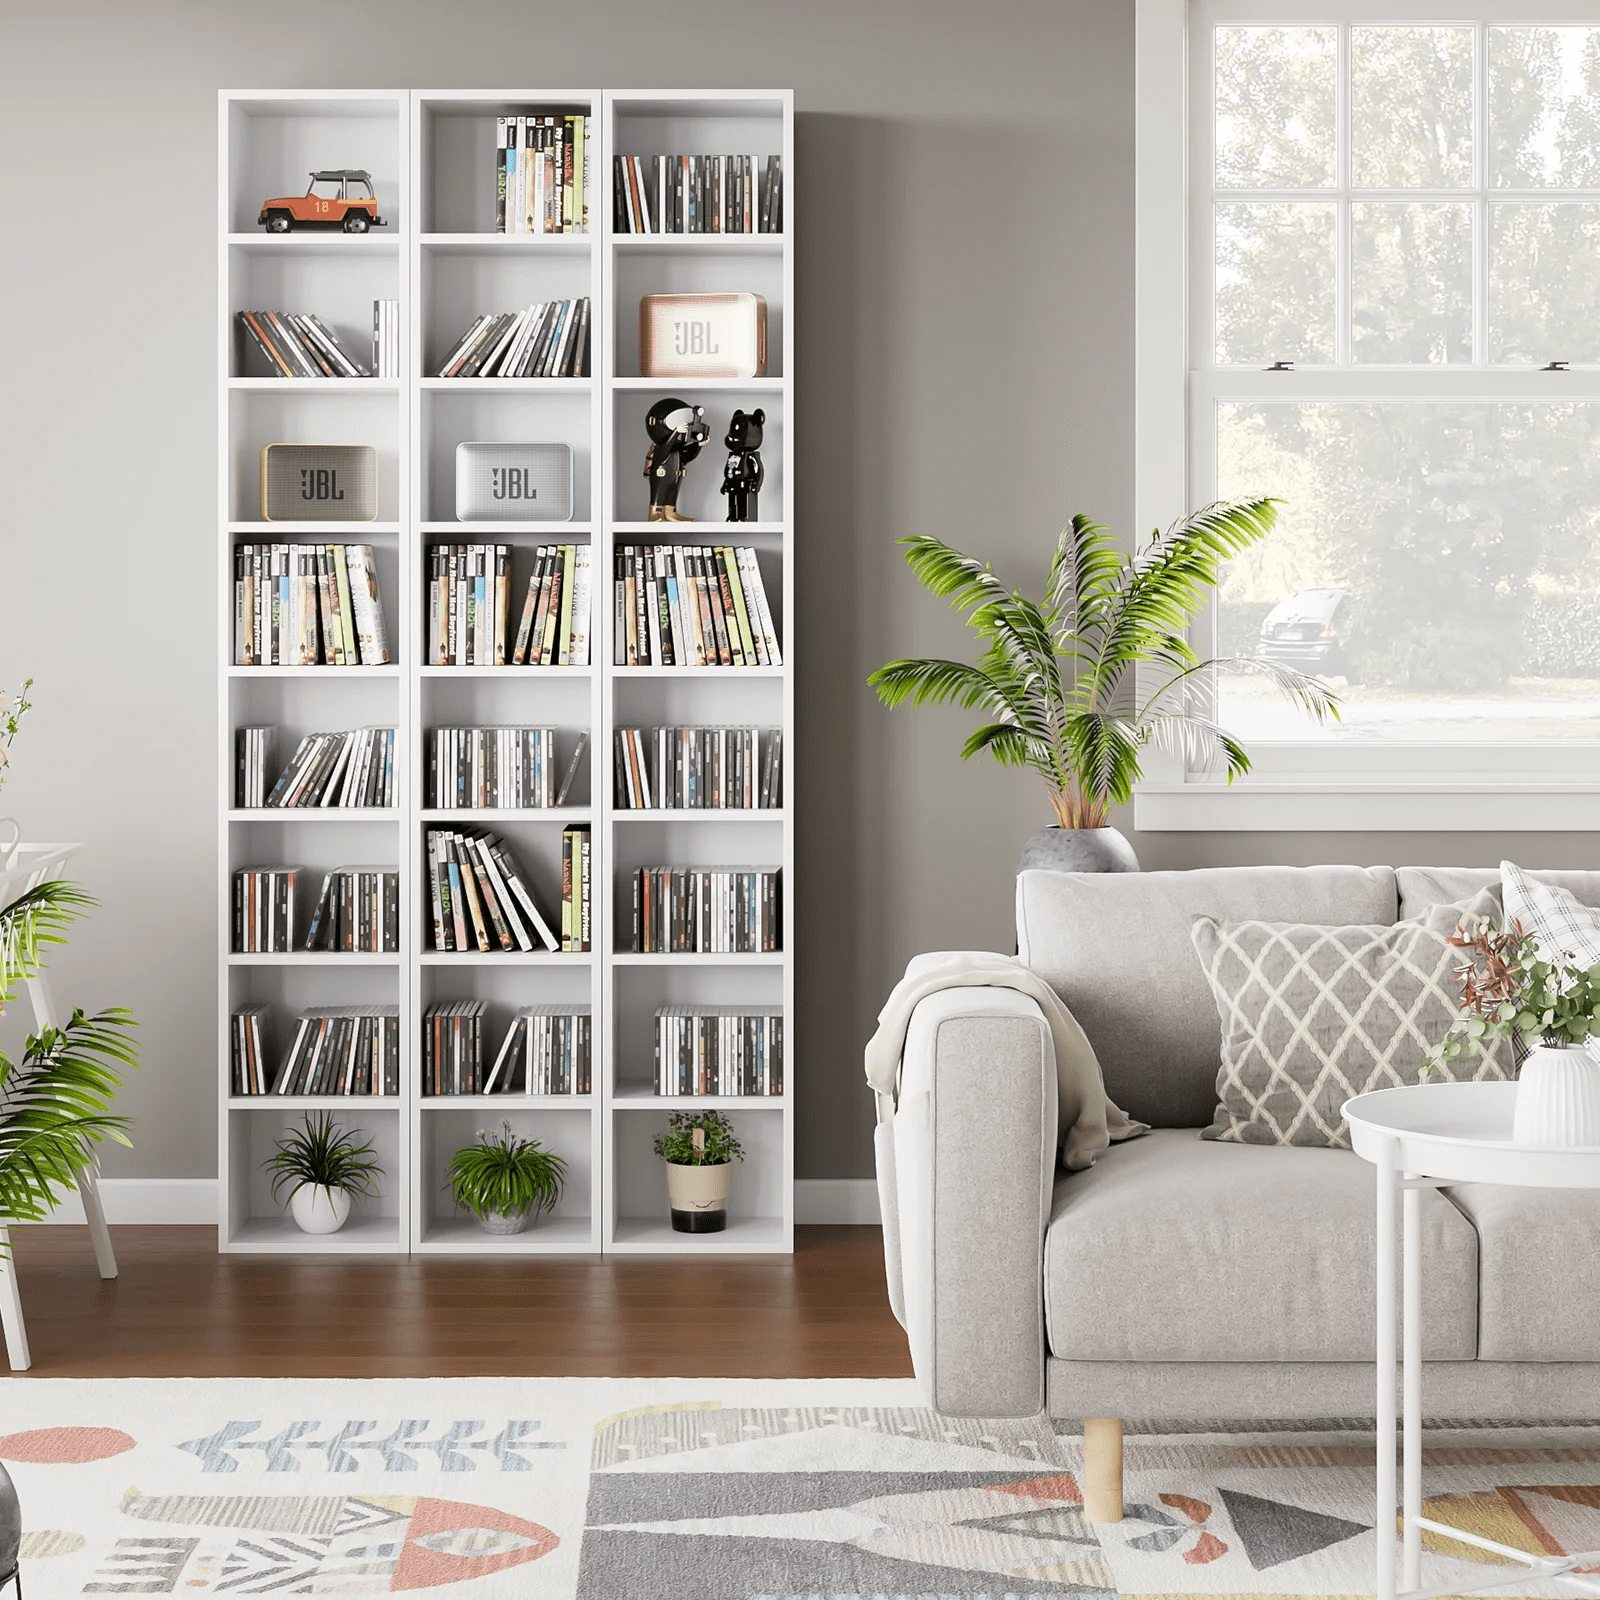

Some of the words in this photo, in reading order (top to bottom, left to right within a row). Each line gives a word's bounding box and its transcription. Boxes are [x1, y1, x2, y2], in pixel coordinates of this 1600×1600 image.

[315, 201, 329, 213] 18
[674, 321, 719, 355] JBL
[300, 469, 344, 500] JBL
[492, 468, 537, 500] JBL
